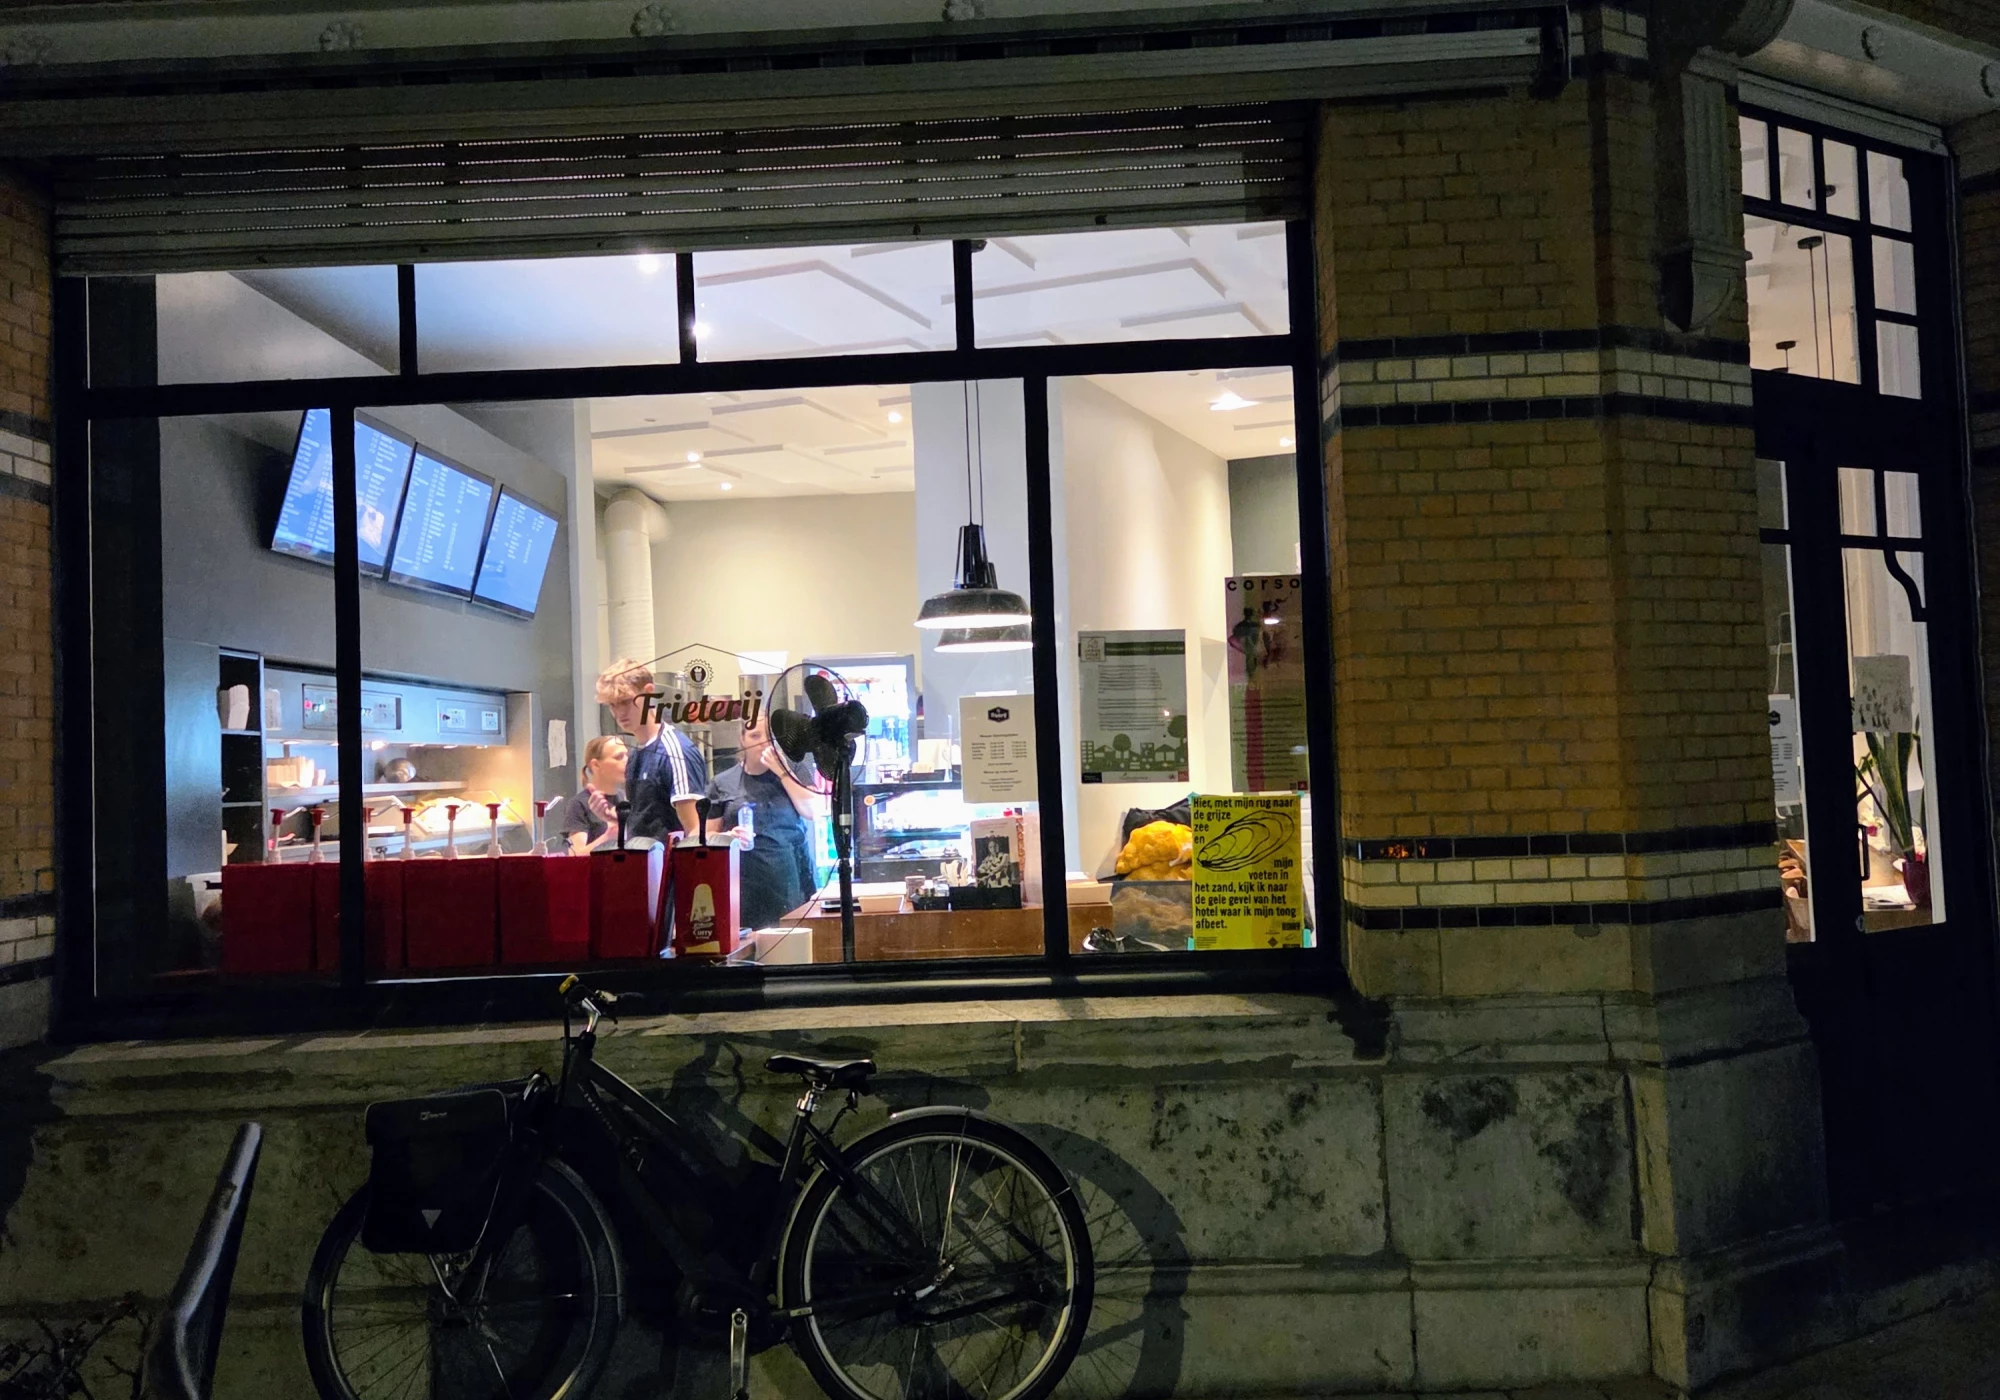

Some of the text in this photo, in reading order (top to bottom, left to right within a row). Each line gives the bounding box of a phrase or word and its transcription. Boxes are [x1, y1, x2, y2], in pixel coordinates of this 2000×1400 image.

[633, 690, 763, 730] Frieterij
[1194, 798, 1294, 809] Hier, met mijn rug naar
[1194, 810, 1231, 821] de grijze
[1194, 824, 1209, 832] zee
[1194, 836, 1204, 844] en
[1274, 857, 1293, 869] mijn
[1249, 870, 1288, 879] voeten in
[1195, 882, 1288, 893] het zand, kijk ik naar
[1195, 894, 1286, 906] de gele gevel van het
[1195, 906, 1296, 918] hotel waar ik mijn tong
[1196, 918, 1228, 929] afbeet.
